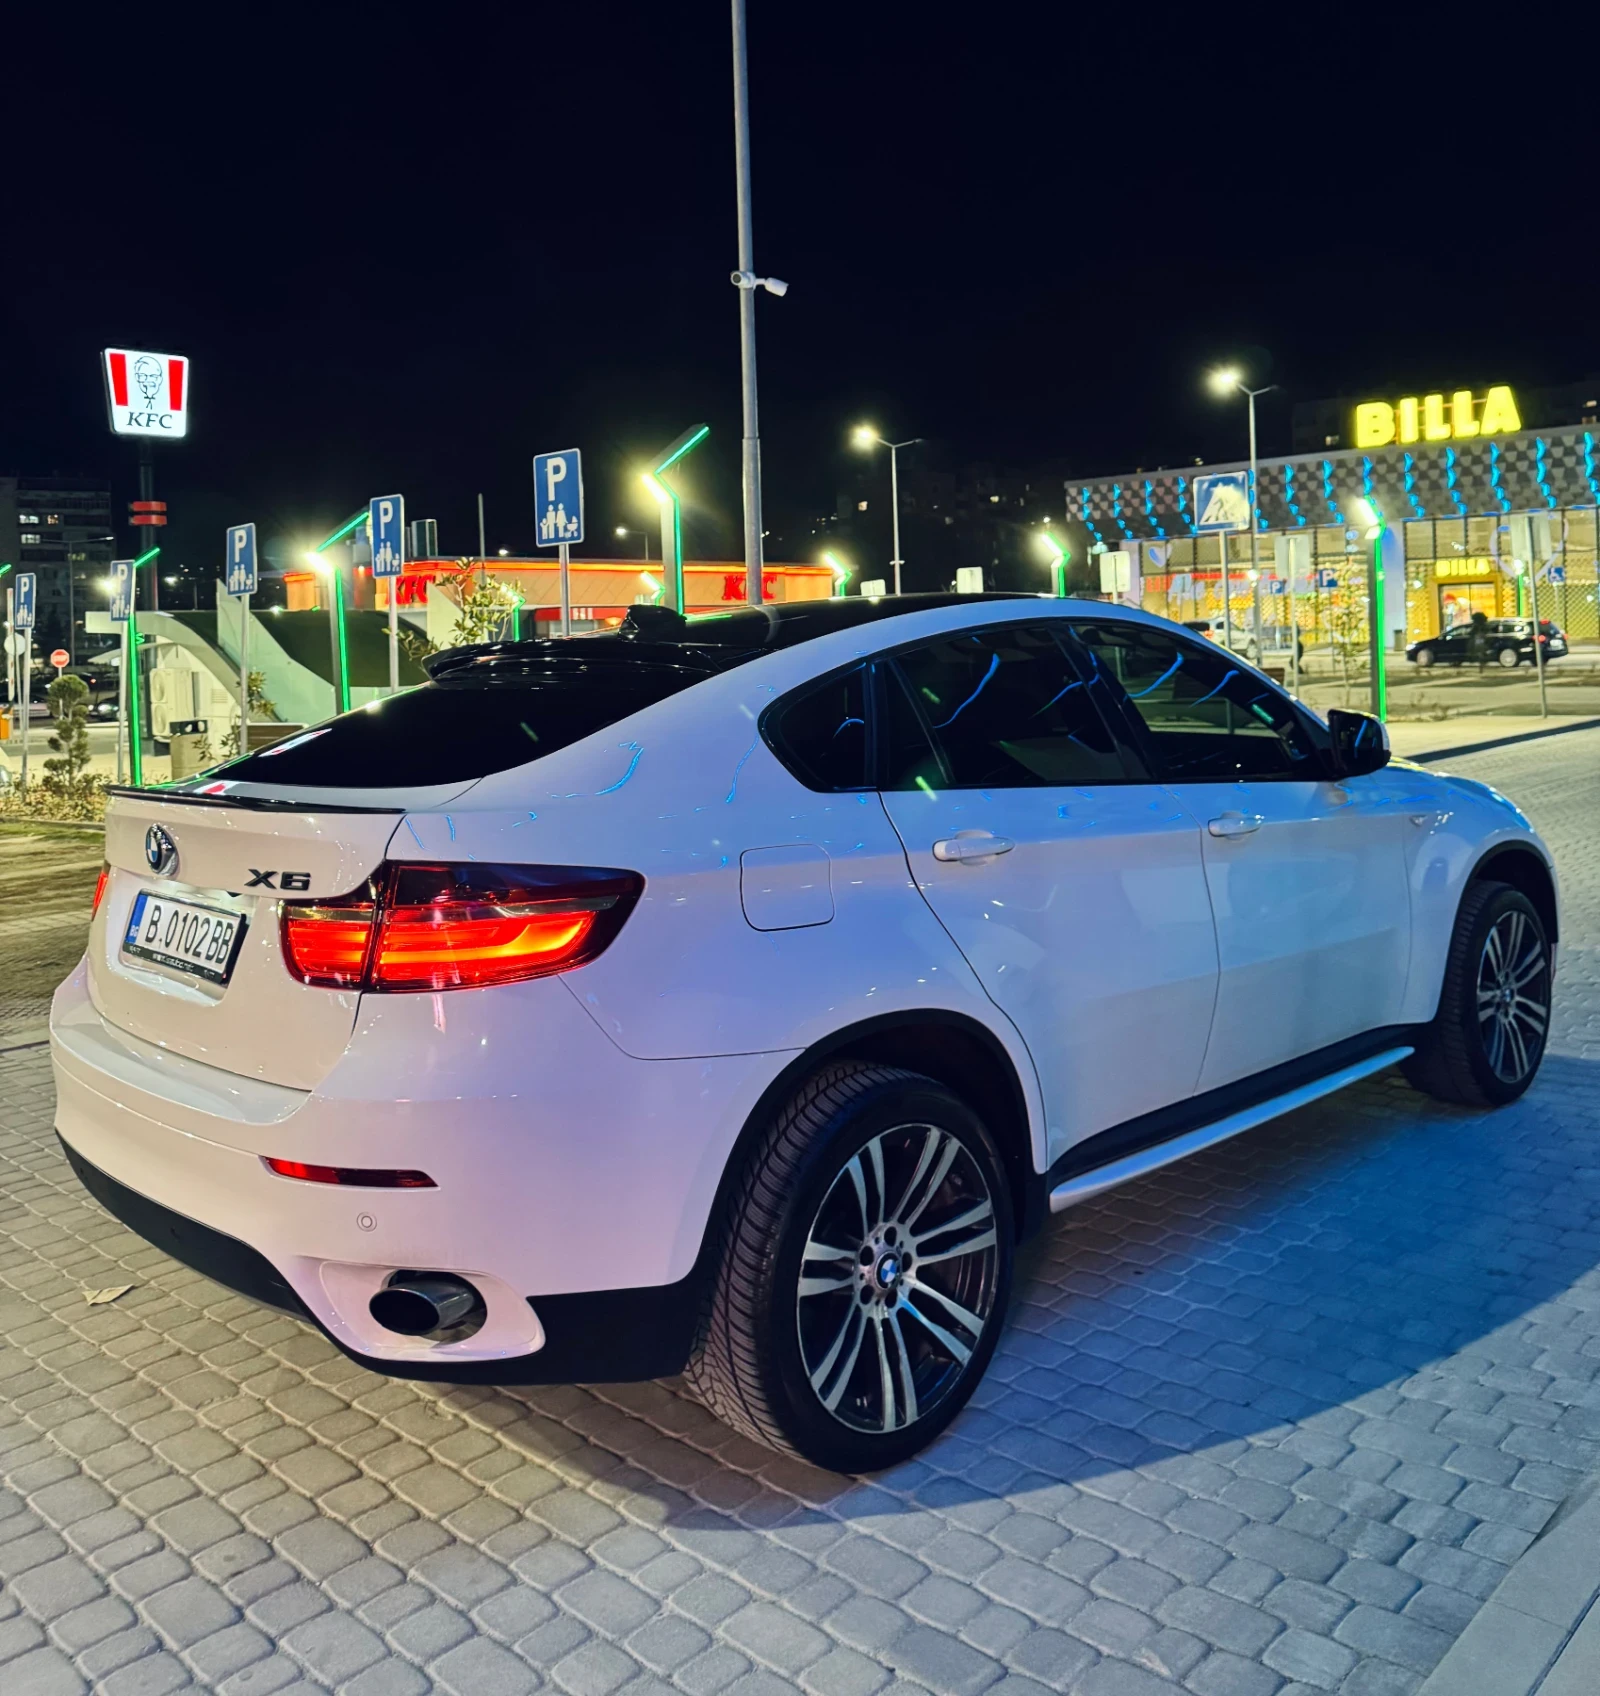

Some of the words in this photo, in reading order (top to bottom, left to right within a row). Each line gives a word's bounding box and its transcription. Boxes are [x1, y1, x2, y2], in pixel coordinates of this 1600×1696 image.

[127, 411, 173, 429] KFC
[1356, 386, 1521, 448] BILLA
[546, 456, 567, 502] P
[379, 500, 394, 540] P
[234, 529, 247, 563] P
[116, 563, 128, 595] P
[1322, 569, 1334, 587] P
[1436, 558, 1490, 577] BILLA
[20, 577, 30, 603] P
[722, 574, 777, 601] KC
[1271, 581, 1281, 593] P
[243, 868, 312, 891] X6
[129, 924, 140, 937] BG
